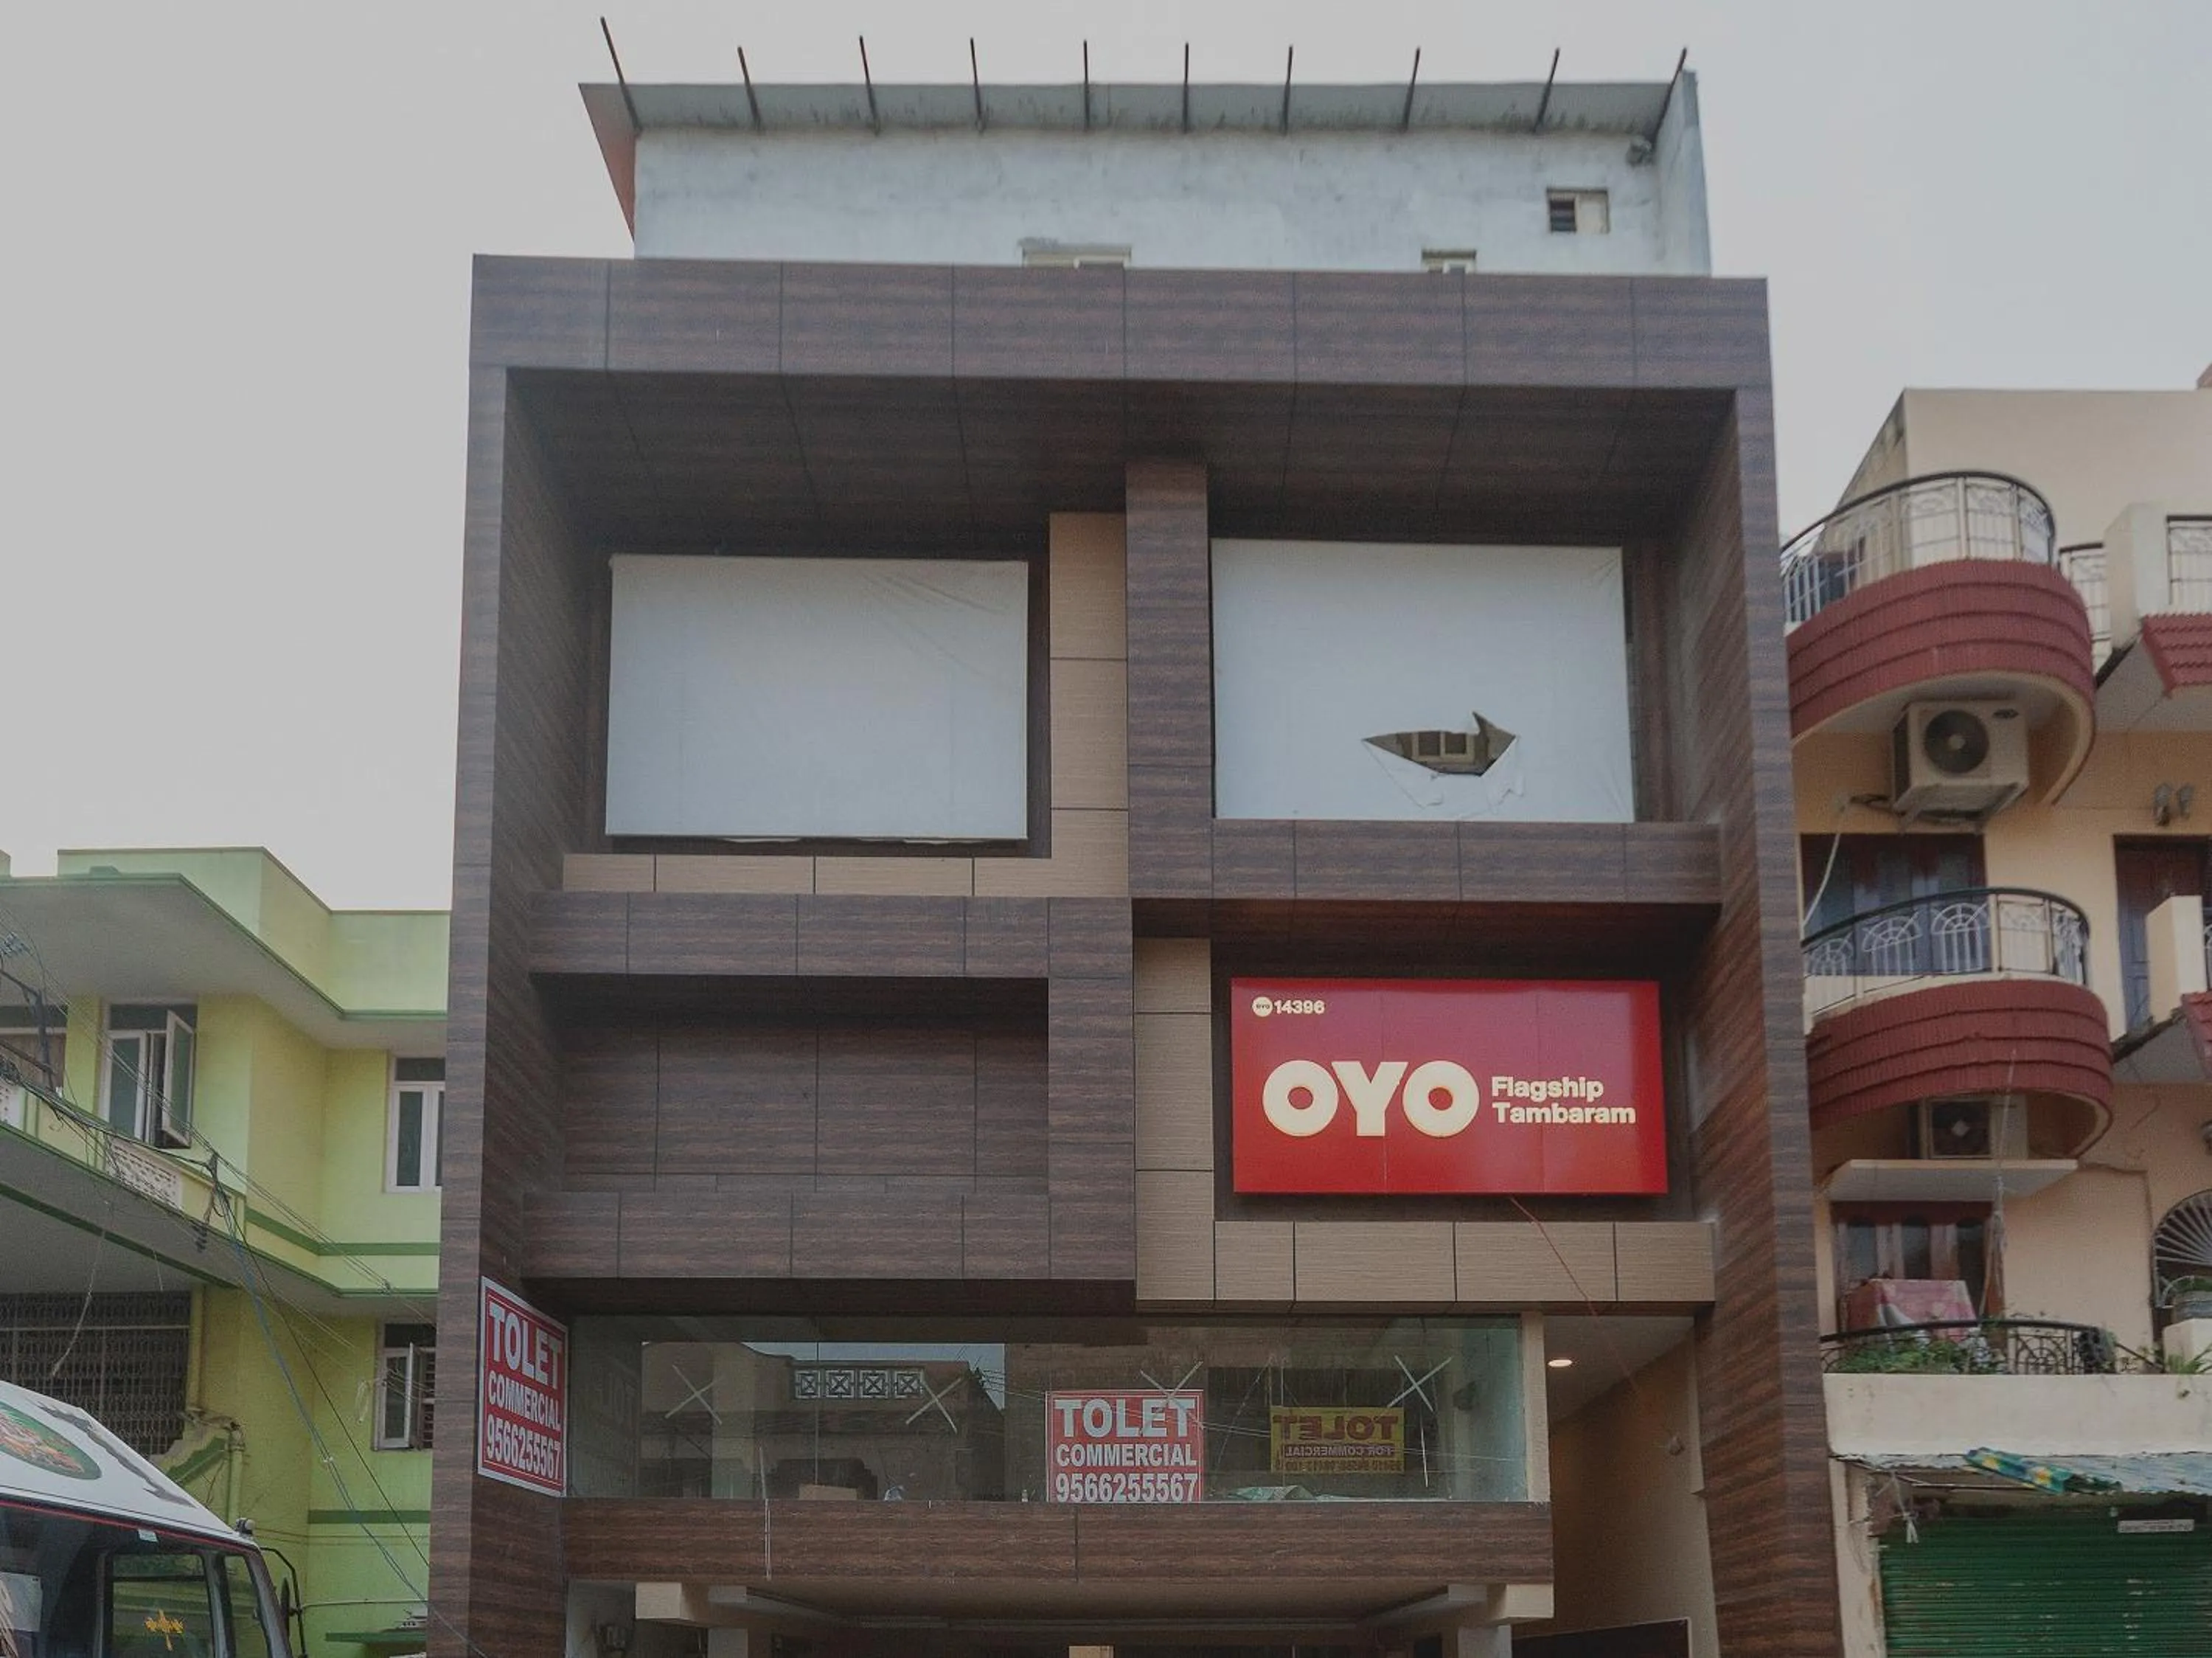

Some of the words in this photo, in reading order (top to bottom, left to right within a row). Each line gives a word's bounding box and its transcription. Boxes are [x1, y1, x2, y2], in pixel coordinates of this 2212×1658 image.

[1262, 1060, 1480, 1137] OYO
[1492, 1076, 1604, 1103] Flagship
[1492, 1102, 1636, 1124] Tambaram
[489, 1302, 563, 1390] TOLET
[487, 1370, 561, 1431] COMMERCIAL
[1054, 1398, 1195, 1437] TOLET
[487, 1415, 561, 1480] 9566255567
[1056, 1443, 1197, 1467] COMMERCIAL
[1055, 1472, 1198, 1503] 9566255567
